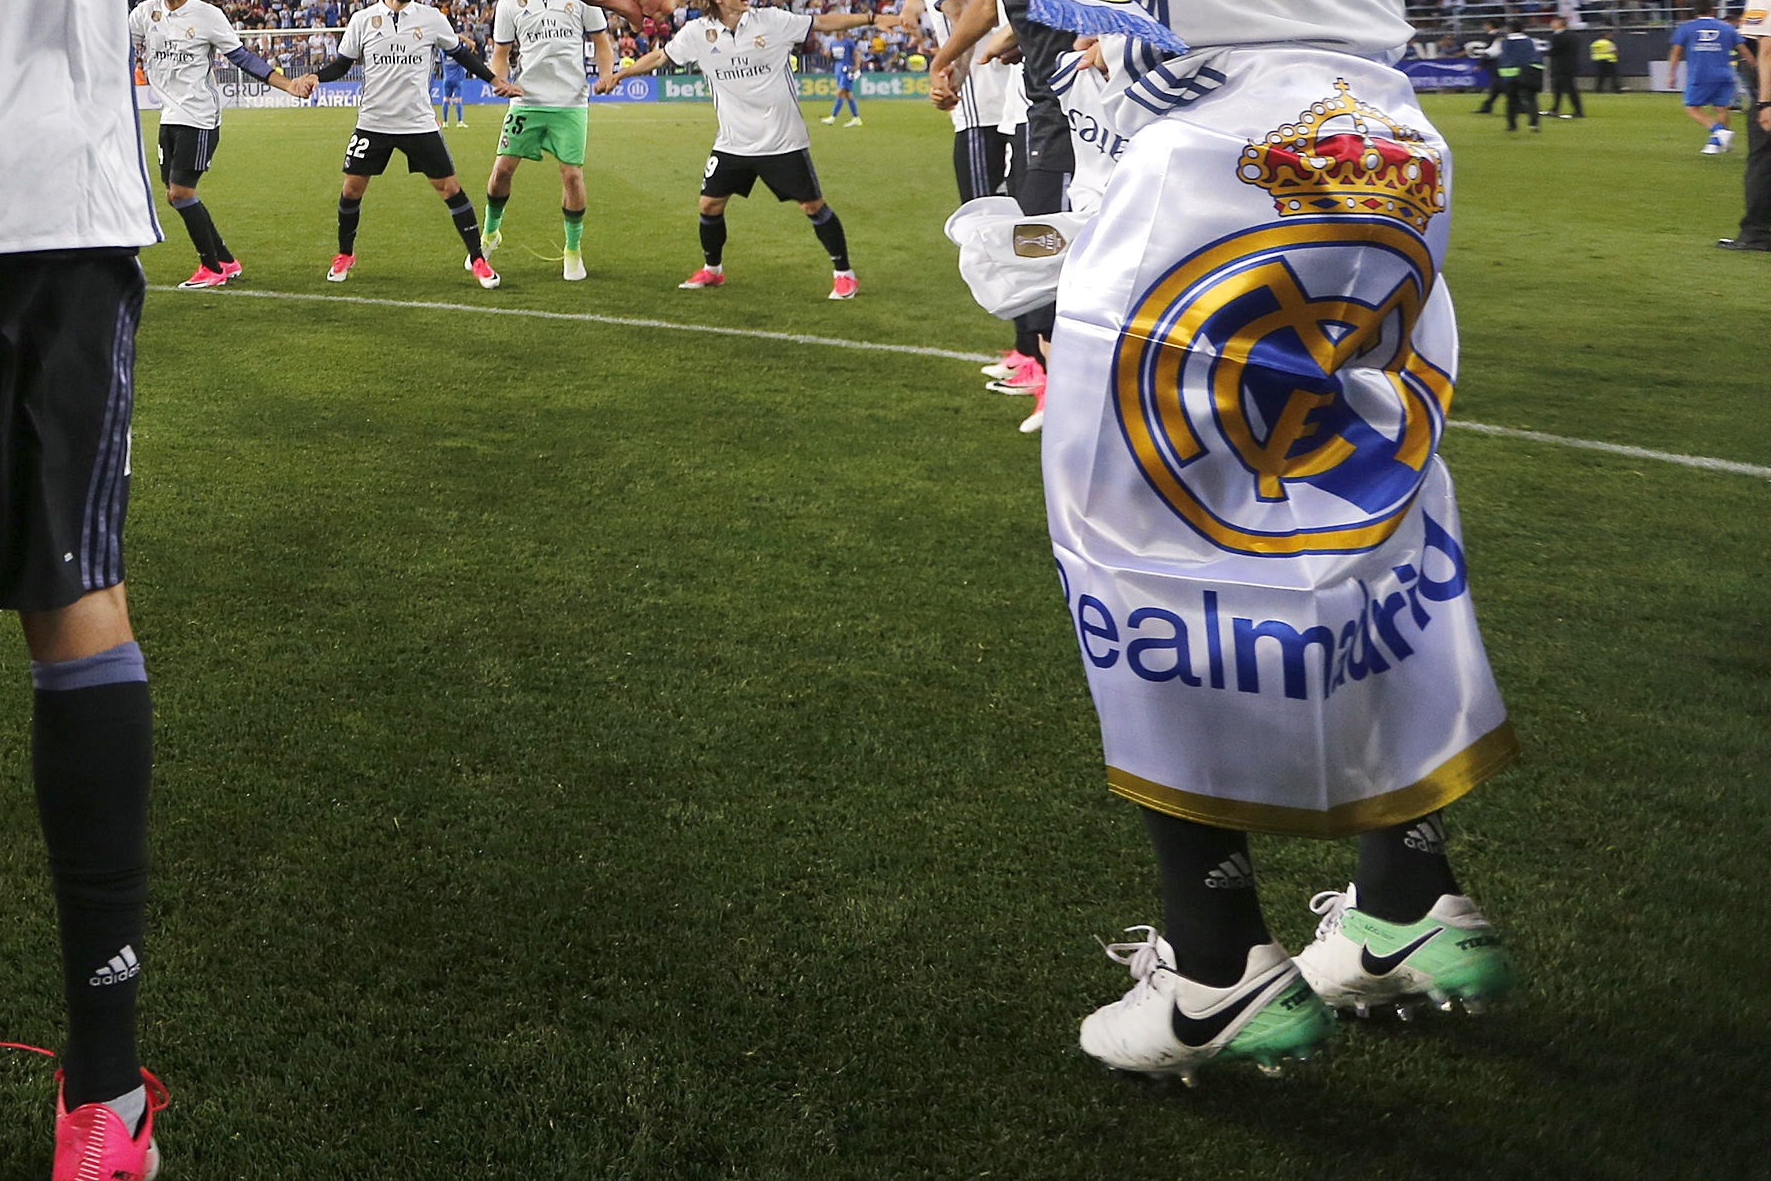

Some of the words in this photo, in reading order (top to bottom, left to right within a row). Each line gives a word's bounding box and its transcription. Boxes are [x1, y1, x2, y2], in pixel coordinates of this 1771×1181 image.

[527, 29, 574, 43] Emirates
[390, 43, 406, 53] Fly
[373, 54, 423, 65] Emirates
[731, 56, 749, 66] Fly
[716, 64, 772, 81] Emirates
[860, 75, 929, 96] bet36
[503, 113, 527, 135] 25
[346, 134, 370, 159] 22
[89, 962, 141, 987] adidas
